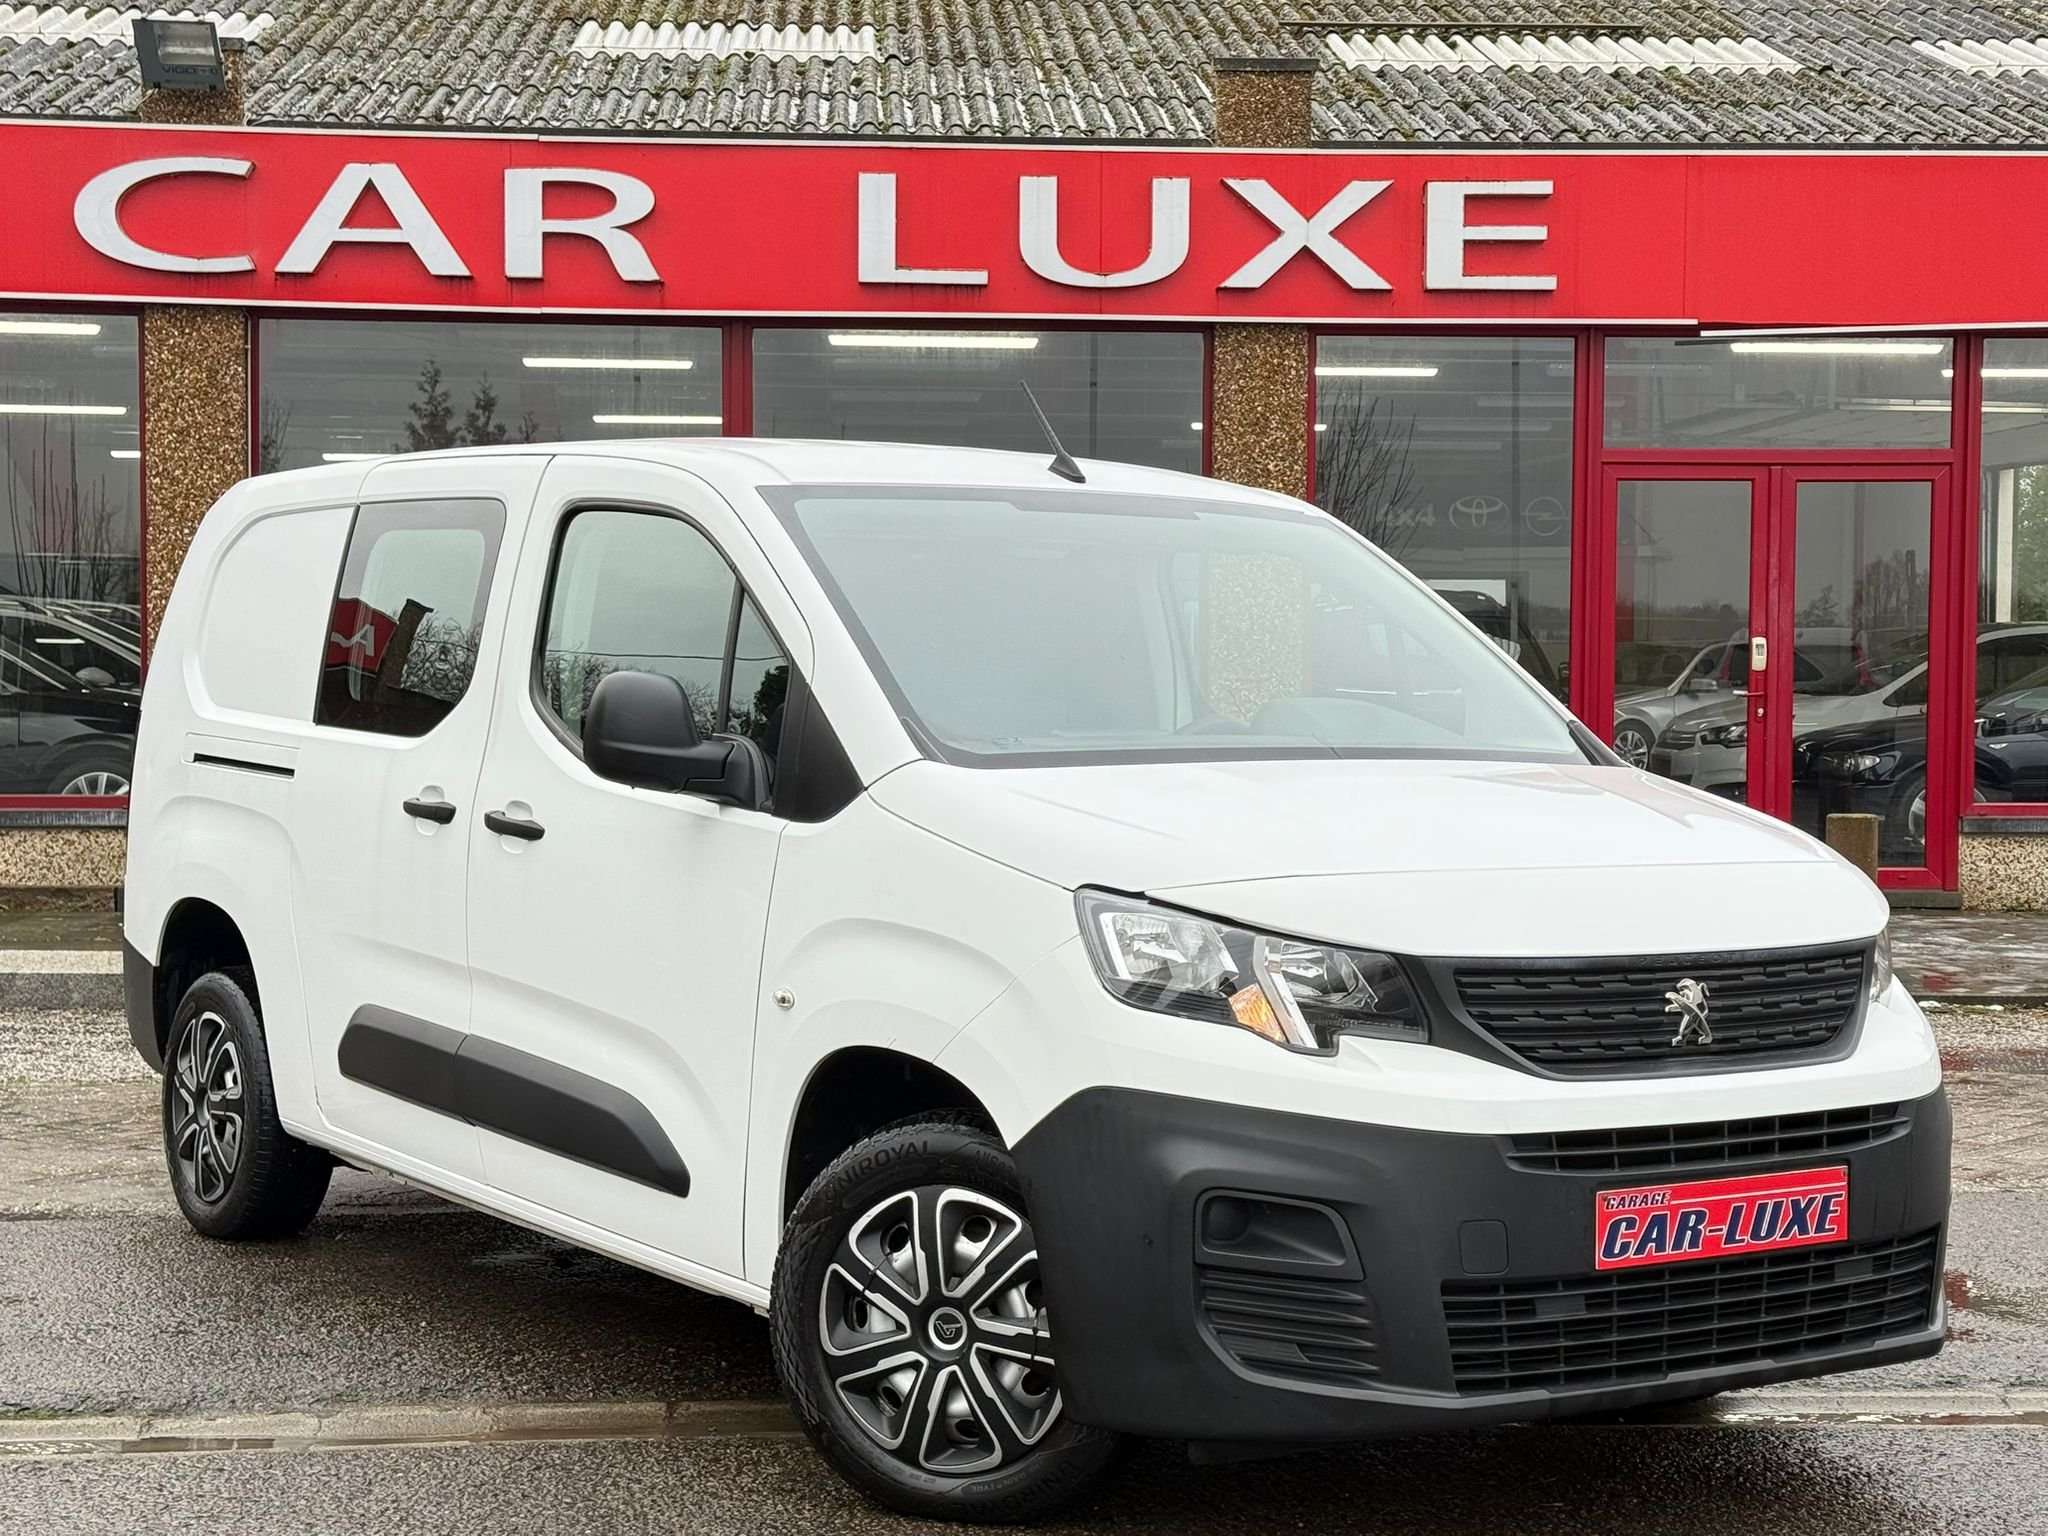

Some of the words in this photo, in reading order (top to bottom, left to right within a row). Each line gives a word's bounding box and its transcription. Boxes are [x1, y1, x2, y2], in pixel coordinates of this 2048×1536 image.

[74, 155, 664, 283] CAR
[856, 171, 1558, 291] LUXE
[1599, 1191, 1846, 1262] CAR-LUXE
[1604, 1190, 1672, 1211] GARAGE
